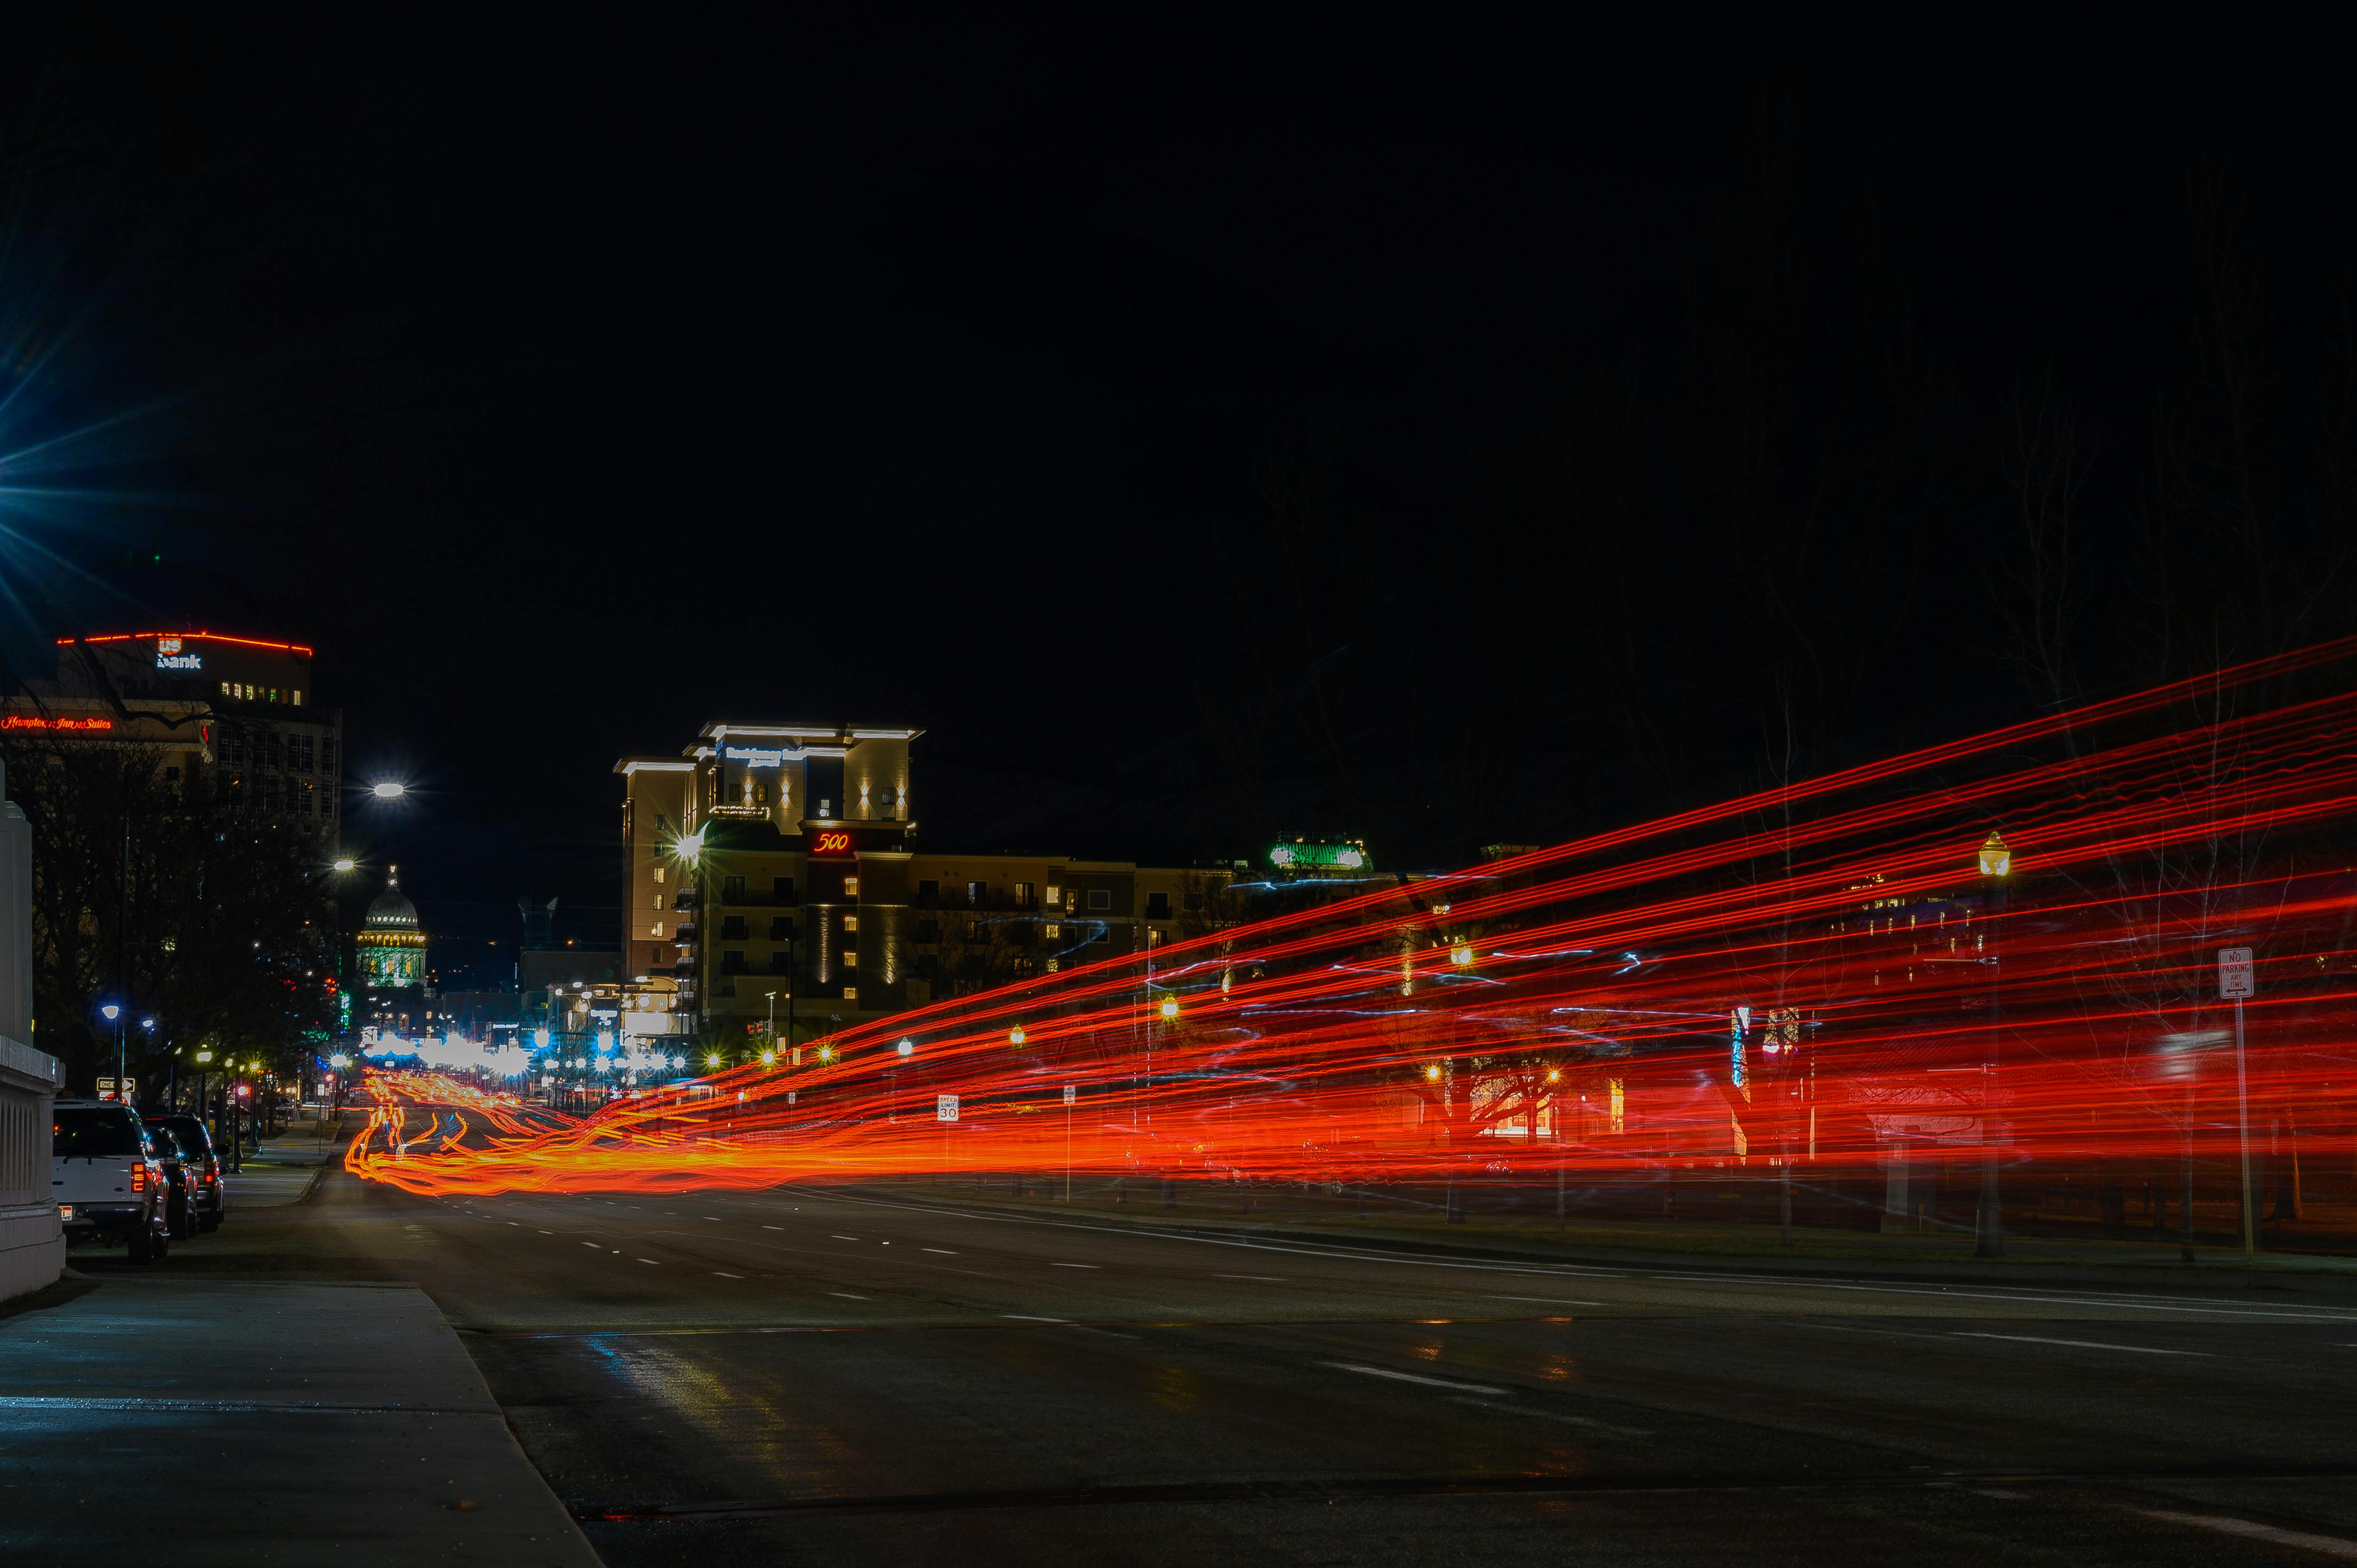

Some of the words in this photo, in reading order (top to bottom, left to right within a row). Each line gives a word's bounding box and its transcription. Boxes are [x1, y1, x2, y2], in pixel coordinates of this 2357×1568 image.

[84, 718, 111, 729] Suites
[815, 834, 848, 851] 500
[2229, 953, 2241, 963] NO
[2222, 963, 2249, 974] PARKING
[940, 1108, 957, 1118] 30
